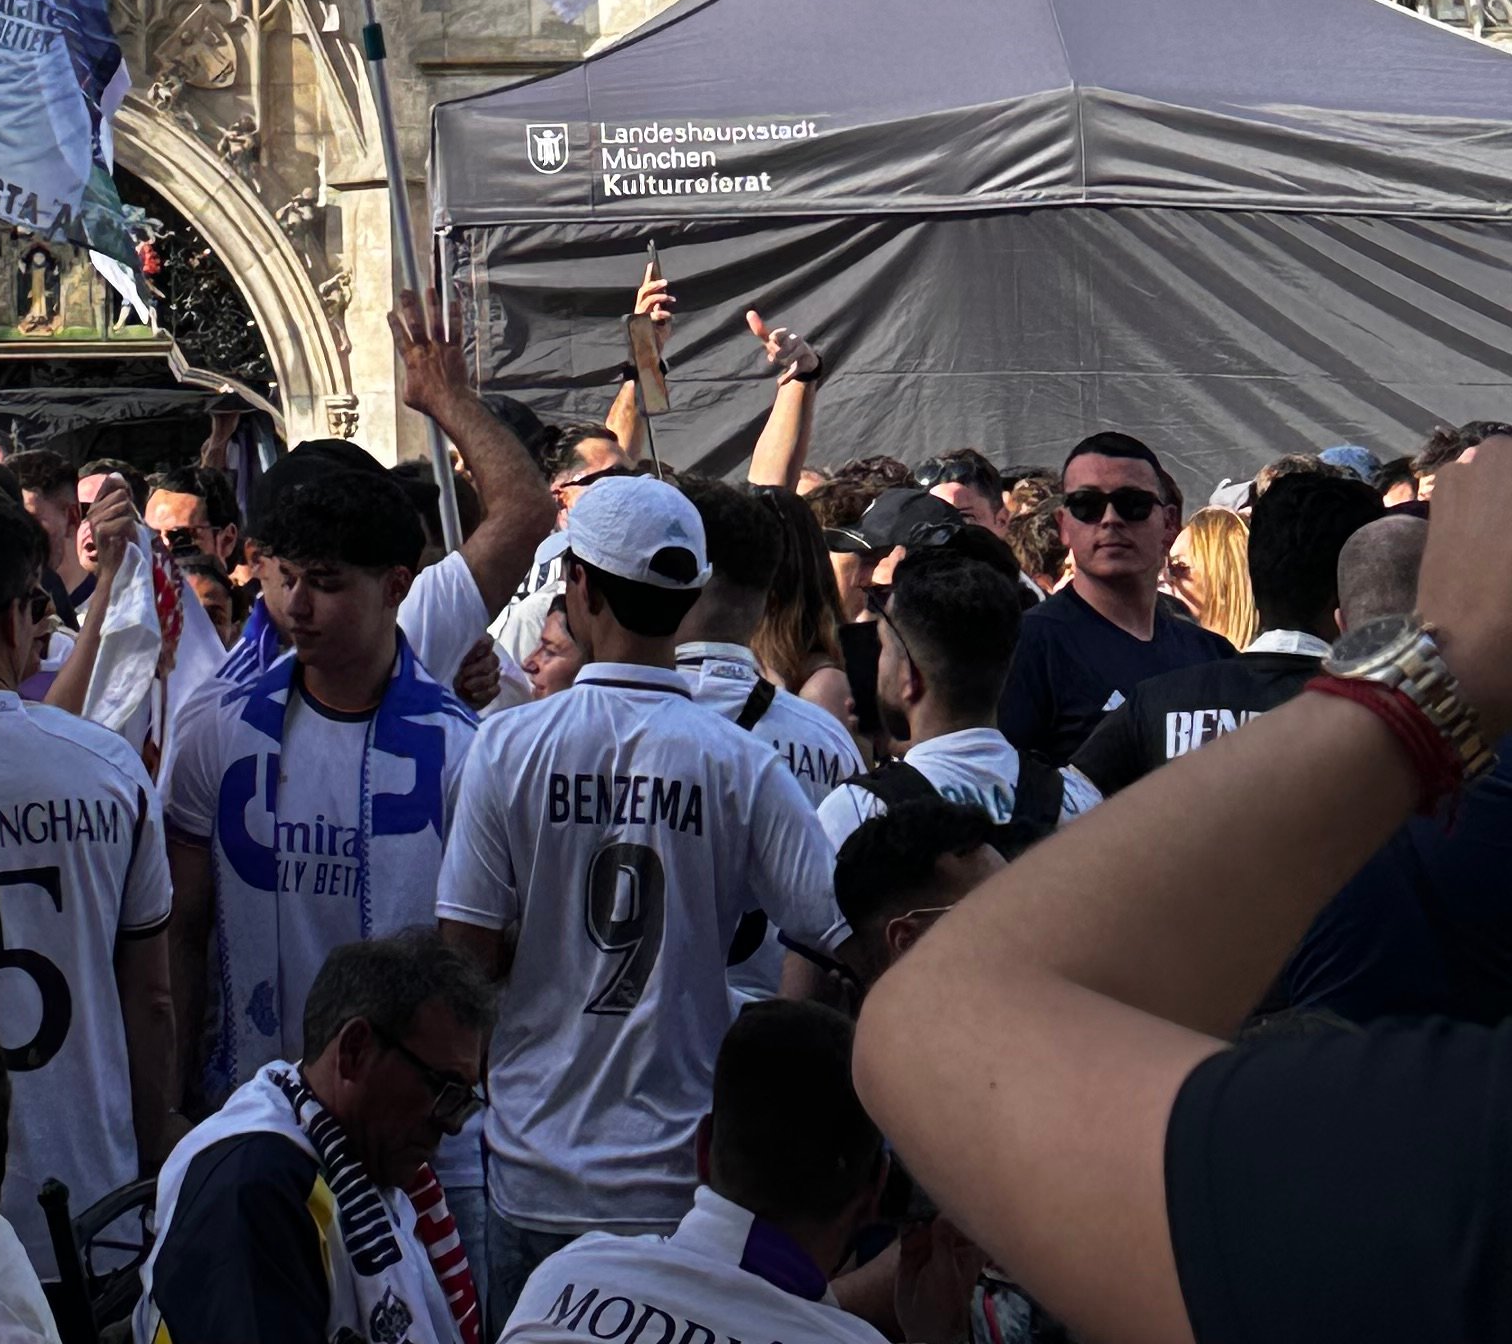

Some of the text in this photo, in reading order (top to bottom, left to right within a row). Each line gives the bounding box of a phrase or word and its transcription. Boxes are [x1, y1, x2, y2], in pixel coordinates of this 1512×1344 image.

[600, 120, 819, 144] Landeshauptstadt
[601, 146, 717, 170] München
[549, 773, 703, 836] BENZEMA
[584, 842, 666, 1016] 9
